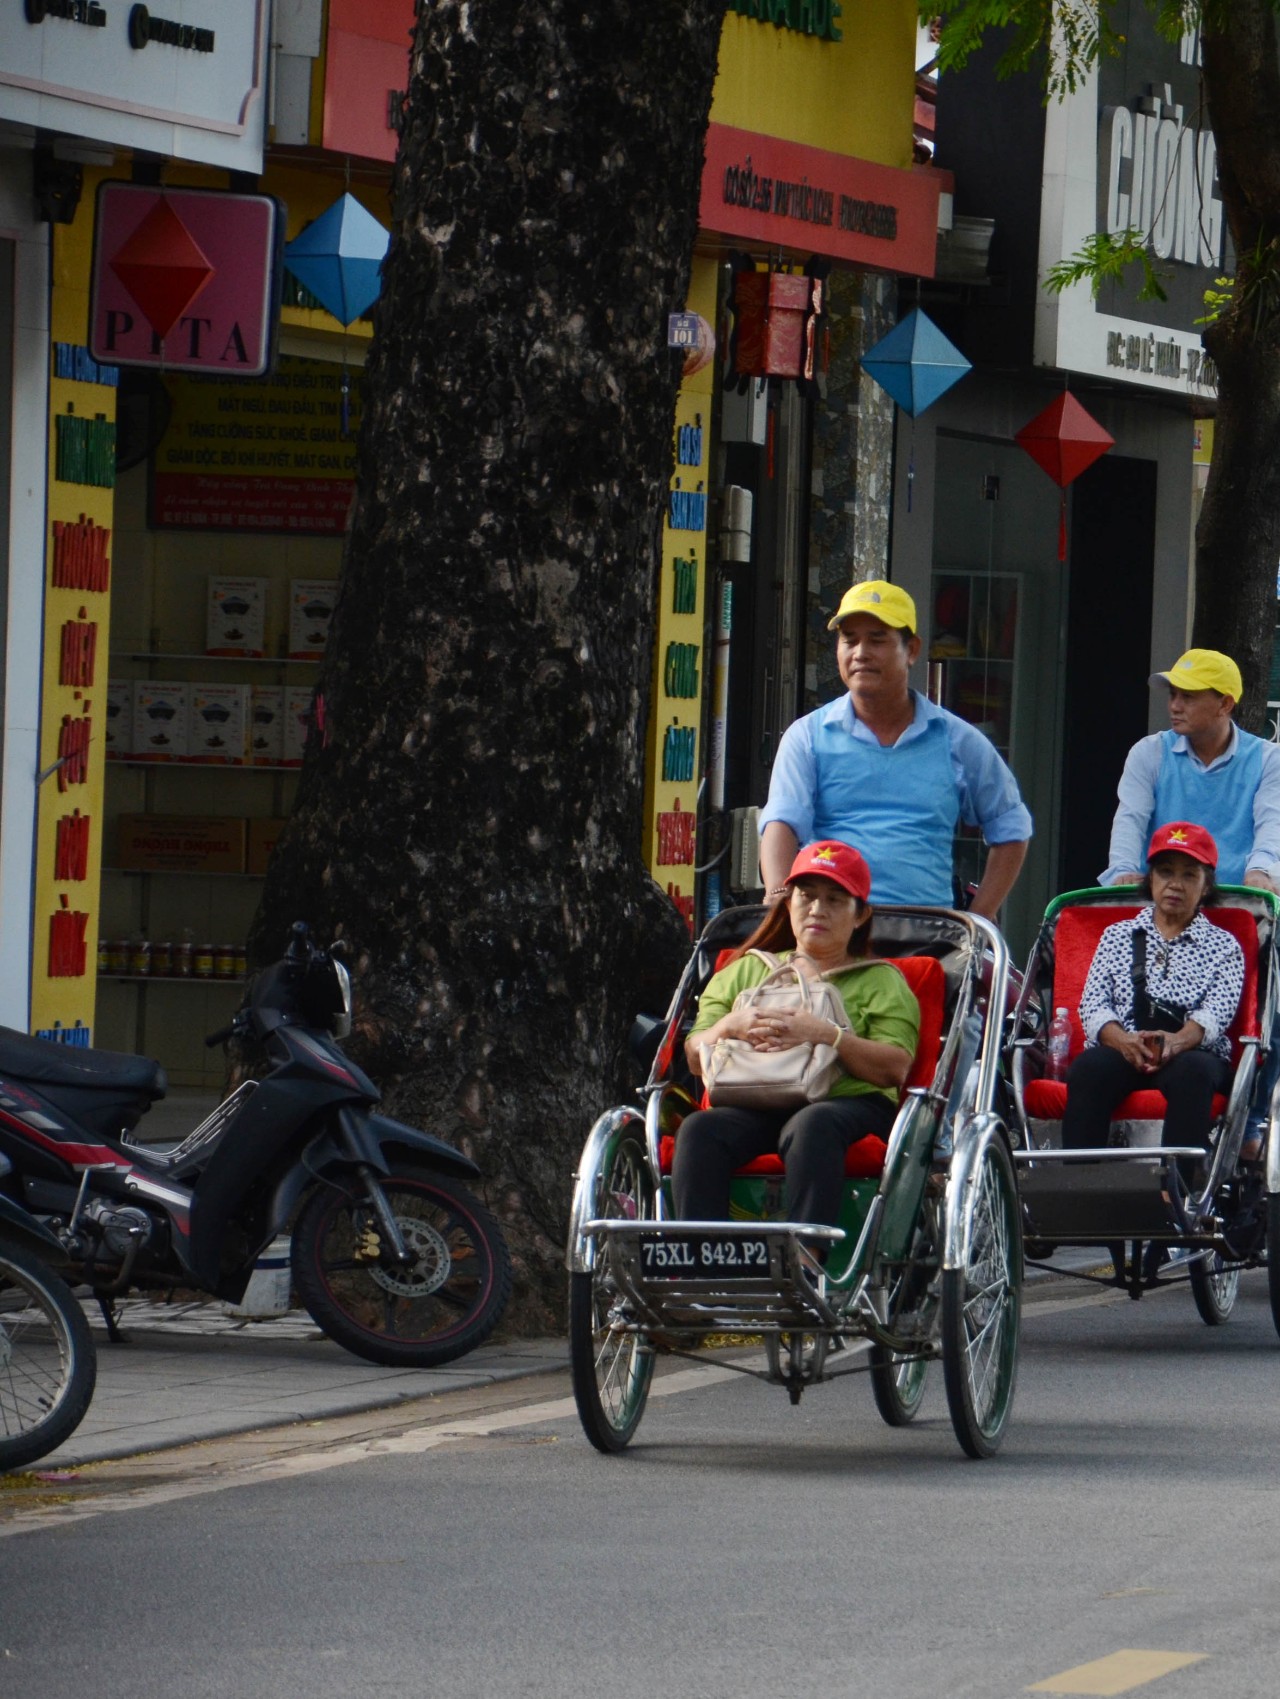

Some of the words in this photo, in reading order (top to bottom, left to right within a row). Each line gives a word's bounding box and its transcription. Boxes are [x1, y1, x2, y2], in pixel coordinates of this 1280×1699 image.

[673, 330, 692, 344] 101
[643, 1242, 694, 1266] 75XL
[701, 1242, 767, 1266] 842.P2
